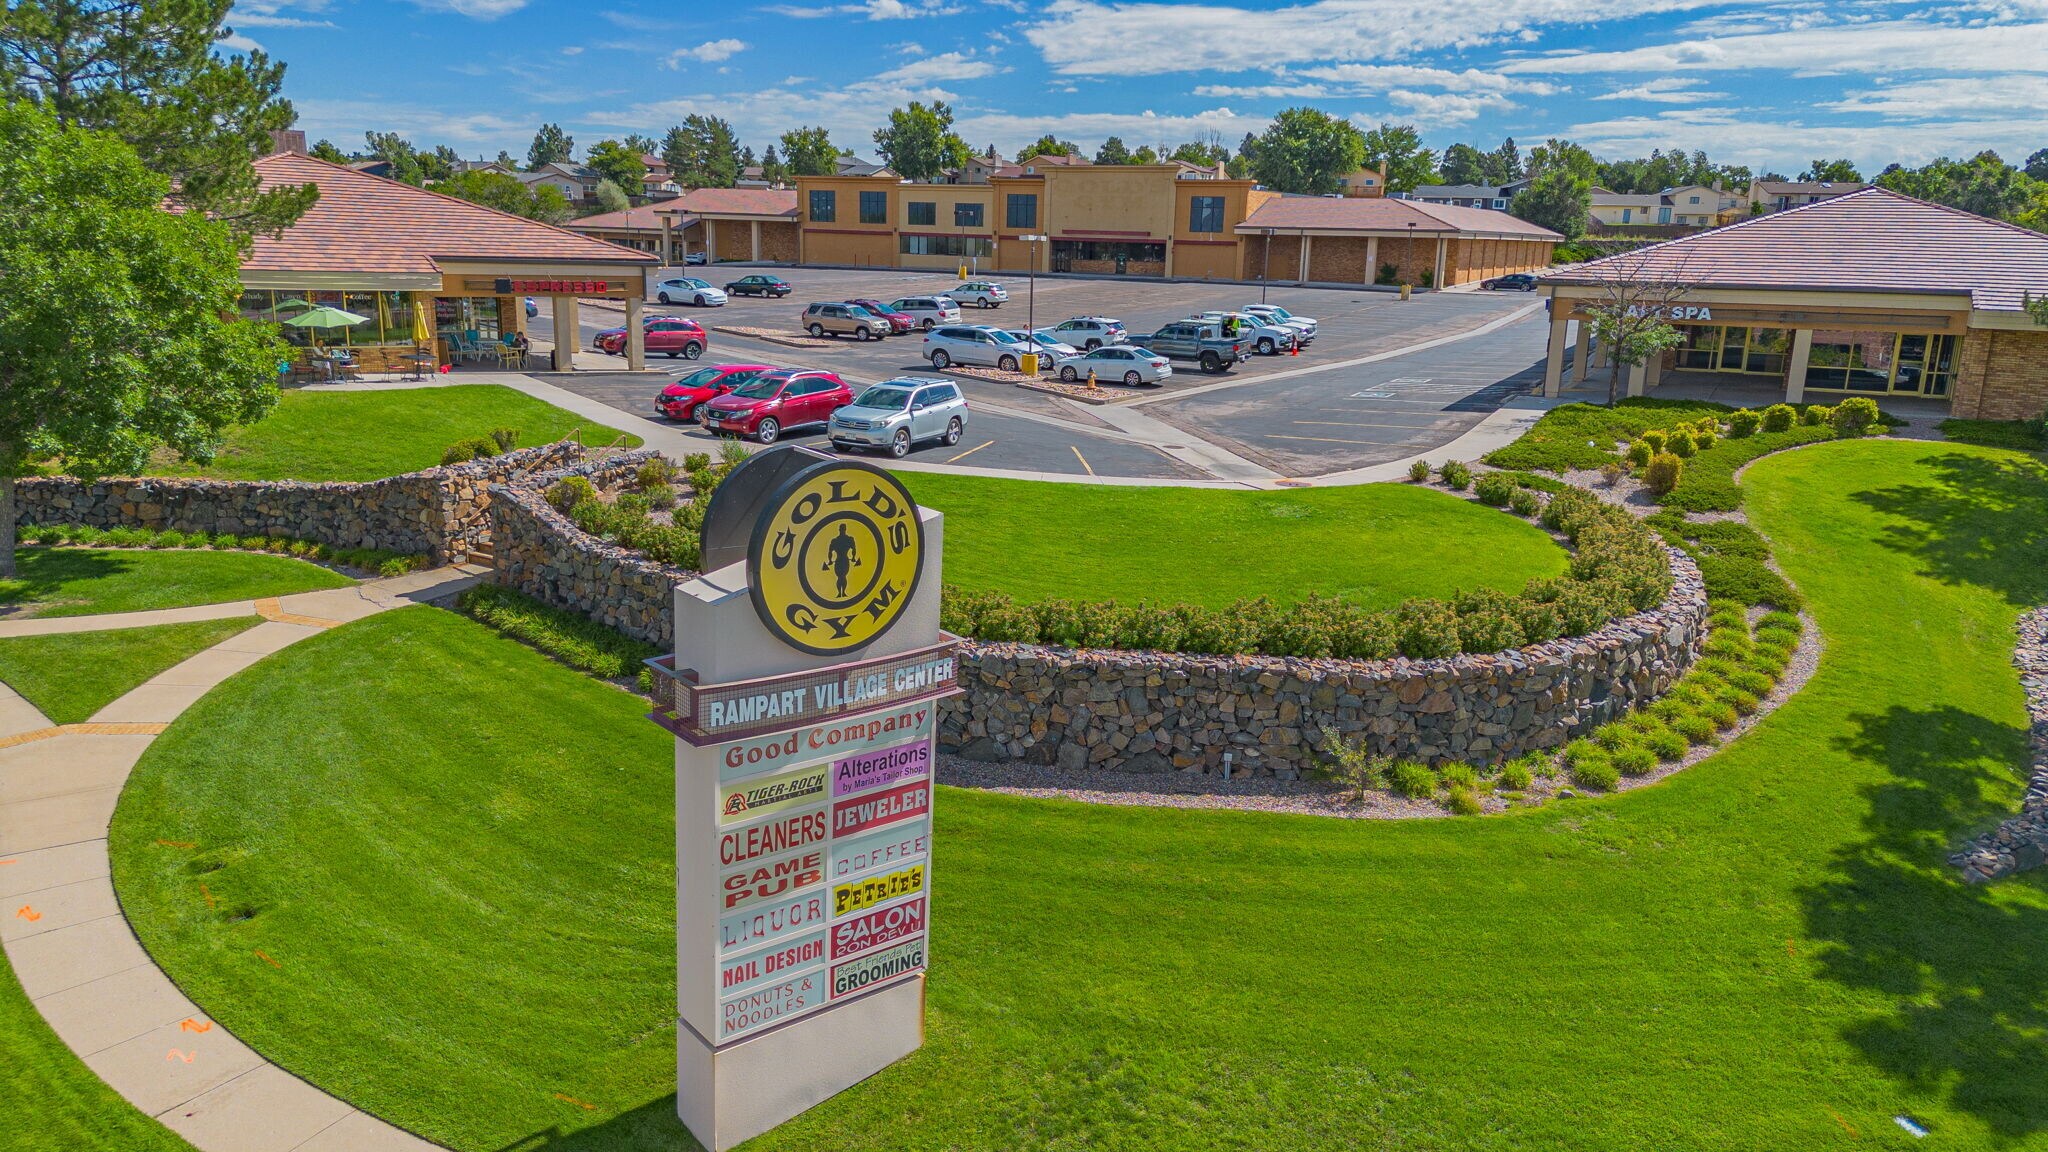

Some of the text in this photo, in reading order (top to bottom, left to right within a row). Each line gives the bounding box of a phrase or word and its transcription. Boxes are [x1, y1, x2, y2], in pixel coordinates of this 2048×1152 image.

[514, 280, 608, 294] ESPRESSO
[1671, 306, 1711, 321] SPA
[772, 480, 911, 570] GOLD'S
[710, 658, 953, 727] RAMPART VILLAGE CENTER
[725, 708, 928, 768] Good Company
[839, 747, 927, 780] Alterations
[842, 765, 923, 792] by Maria's Tailor Shop
[746, 774, 825, 802] TIGER-ROCK
[836, 788, 927, 830] JEWELER
[720, 811, 826, 865] CLEANERS
[837, 836, 926, 875] COFFEE
[724, 852, 820, 890] GAME
[726, 869, 821, 908] PUB
[723, 899, 821, 948] LIQUOR
[836, 900, 921, 945] SALON
[836, 921, 920, 957] RON DEV U
[723, 939, 823, 988] NAIL DESIGN
[836, 951, 922, 994] GROOMING
[837, 941, 920, 978] Best Friends Pet
[726, 977, 812, 1017] DONUTS &
[726, 996, 804, 1033] NOODLES
